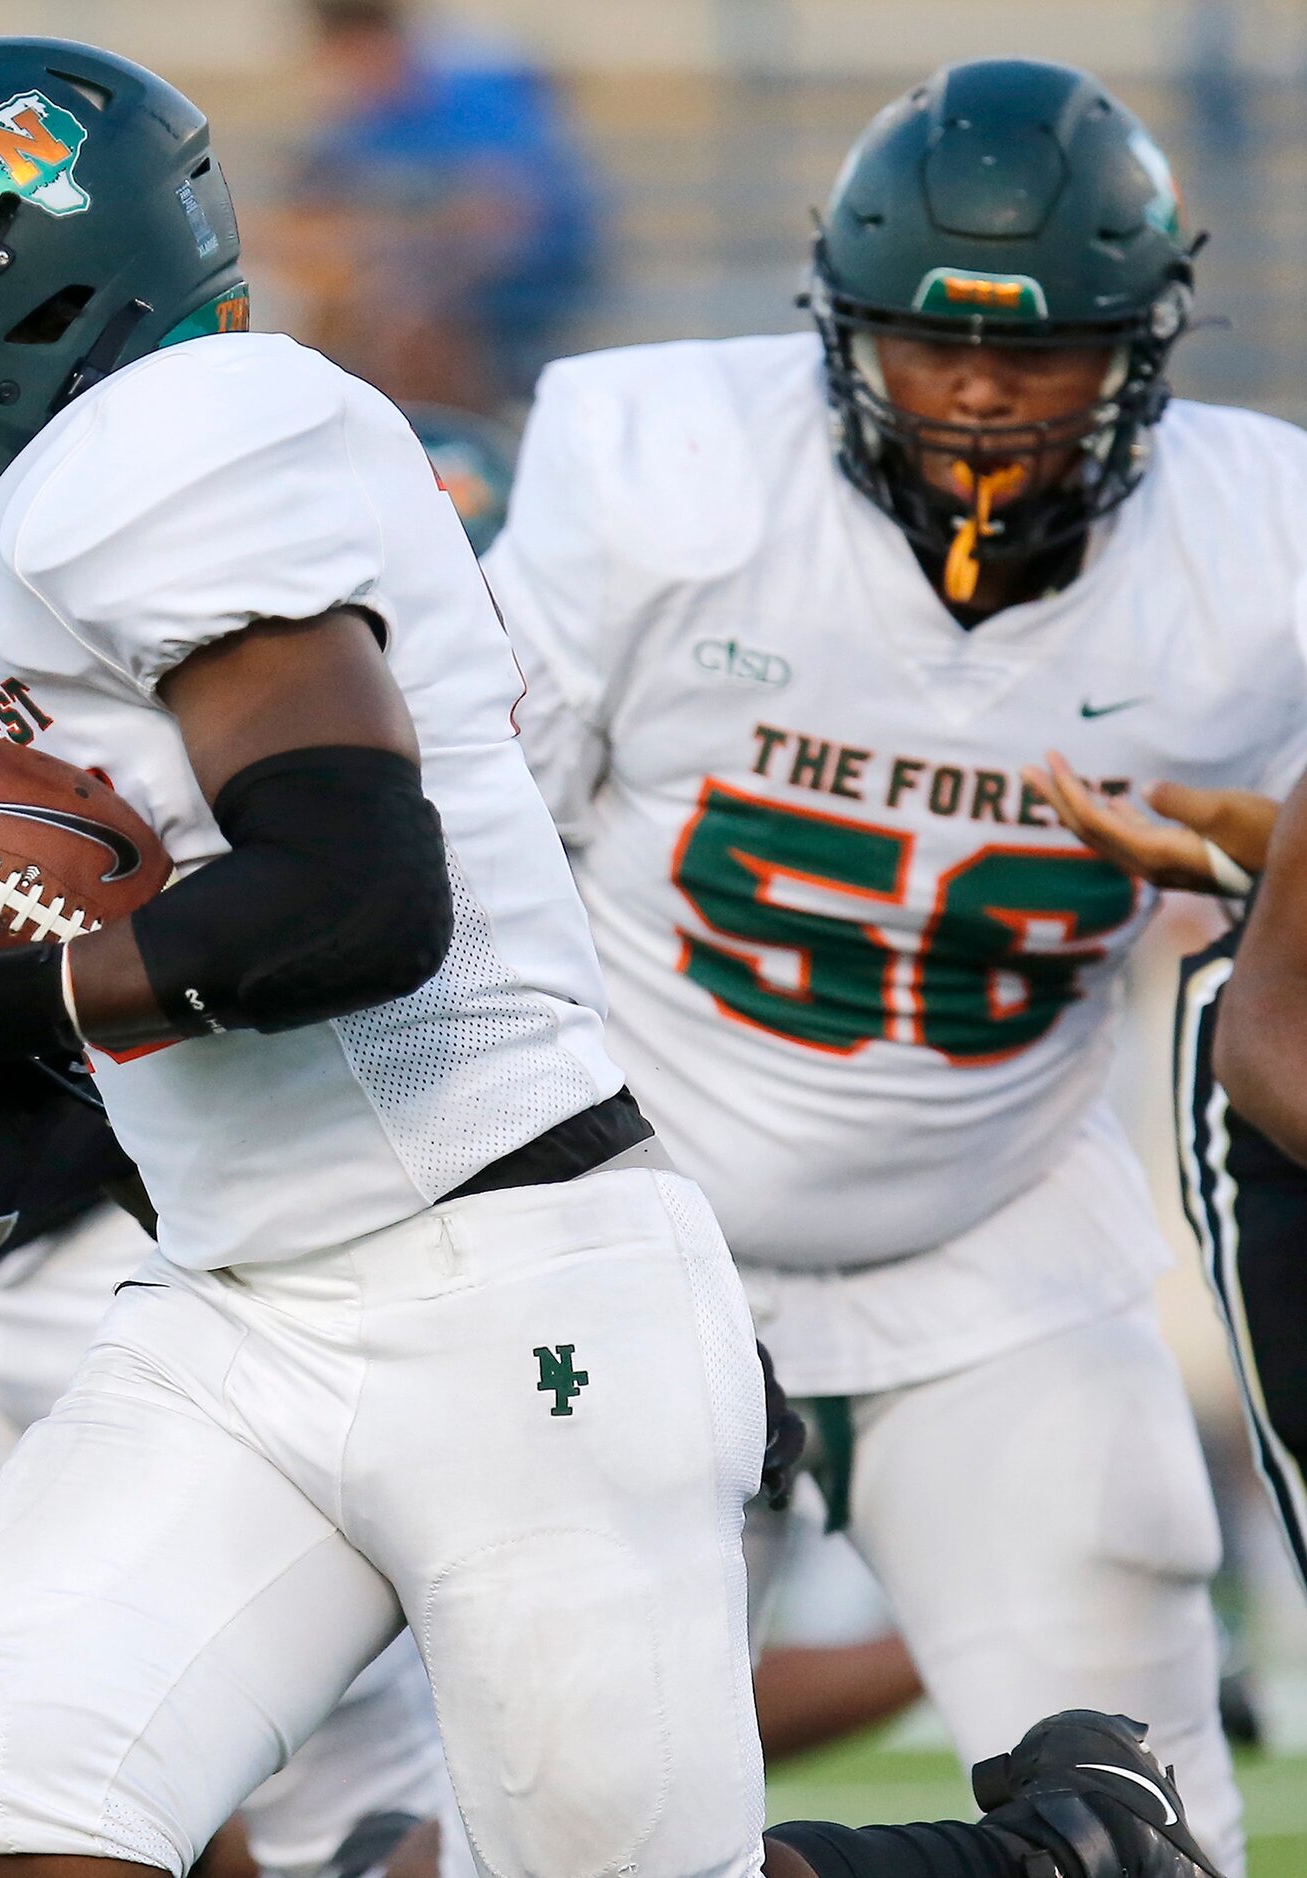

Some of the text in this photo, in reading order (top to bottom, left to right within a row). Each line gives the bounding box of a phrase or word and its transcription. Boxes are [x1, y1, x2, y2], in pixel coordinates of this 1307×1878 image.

[753, 722, 1131, 827] THE FORE
[671, 775, 1141, 1067] 56
